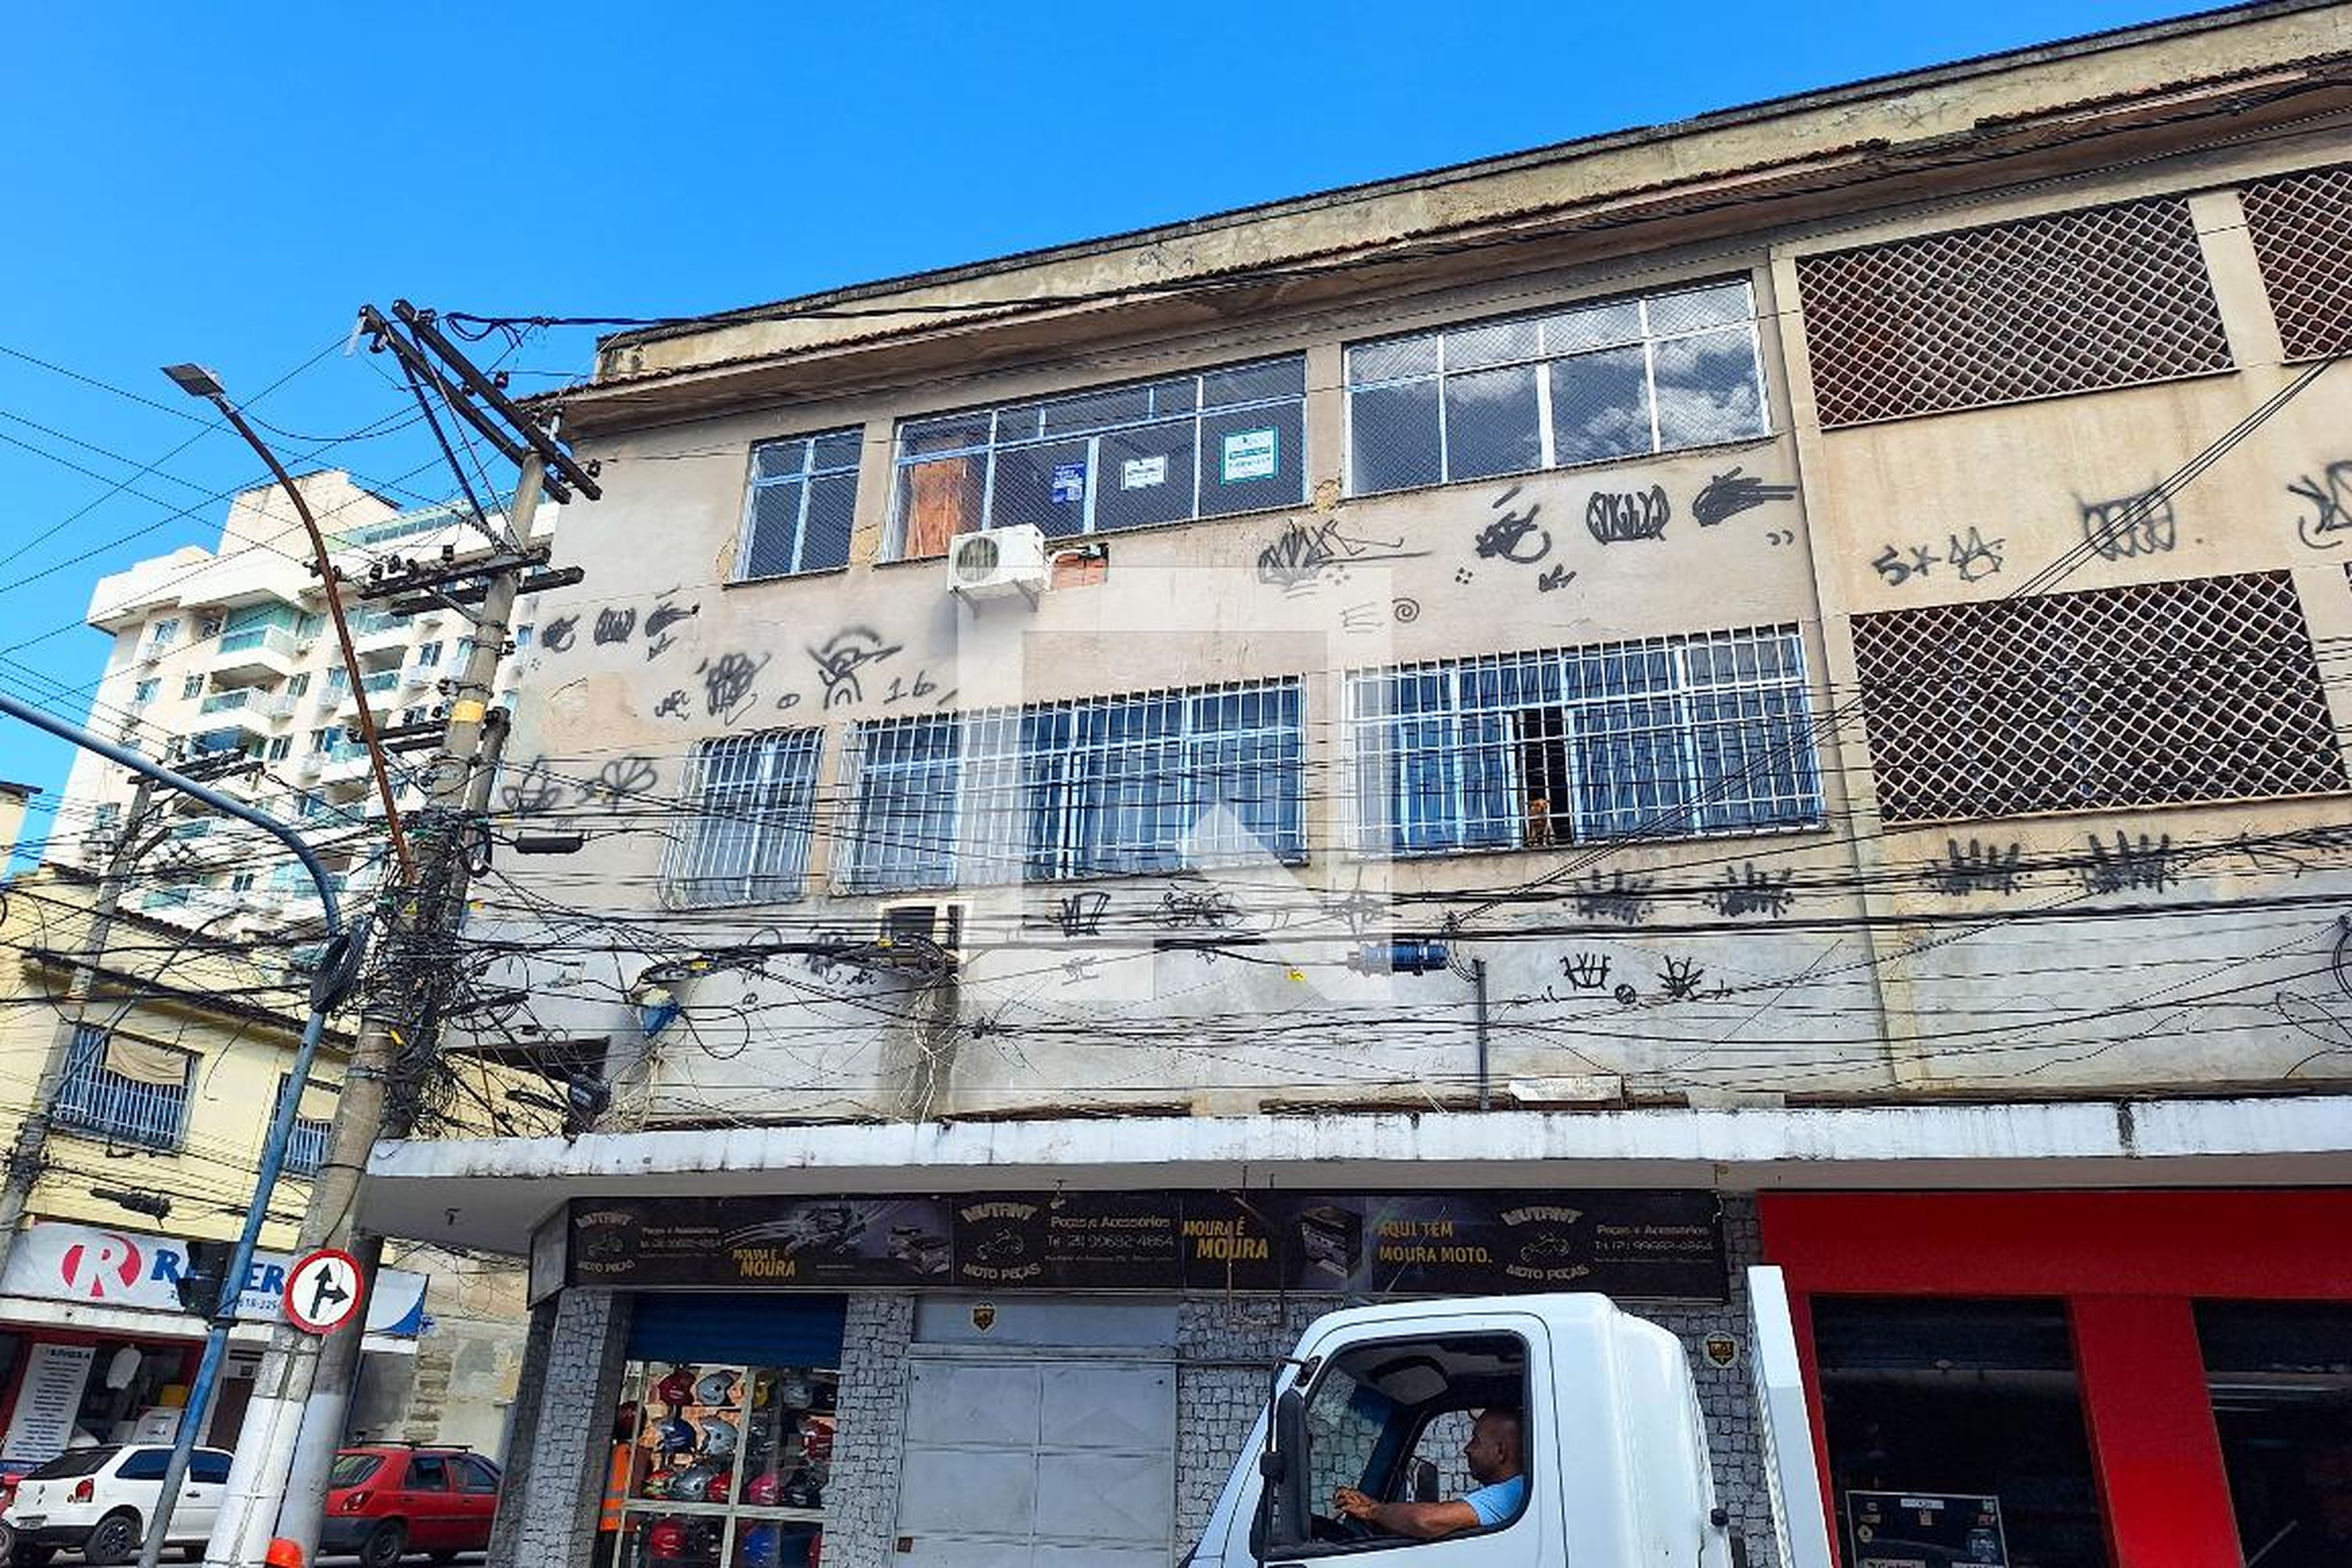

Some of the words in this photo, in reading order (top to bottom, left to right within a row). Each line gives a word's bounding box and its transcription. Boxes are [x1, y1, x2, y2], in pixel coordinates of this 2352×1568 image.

[1182, 1220, 1232, 1237] MOURA
[1378, 1221, 1417, 1238] AQUI
[1421, 1221, 1453, 1238] TEM
[1196, 1238, 1268, 1259] MOURA
[1379, 1246, 1437, 1263] MOURA
[1440, 1246, 1493, 1264] MOTO.
[740, 1259, 796, 1278] MOURA
[962, 1262, 998, 1280] MOTO
[1506, 1264, 1544, 1280] MOTO
